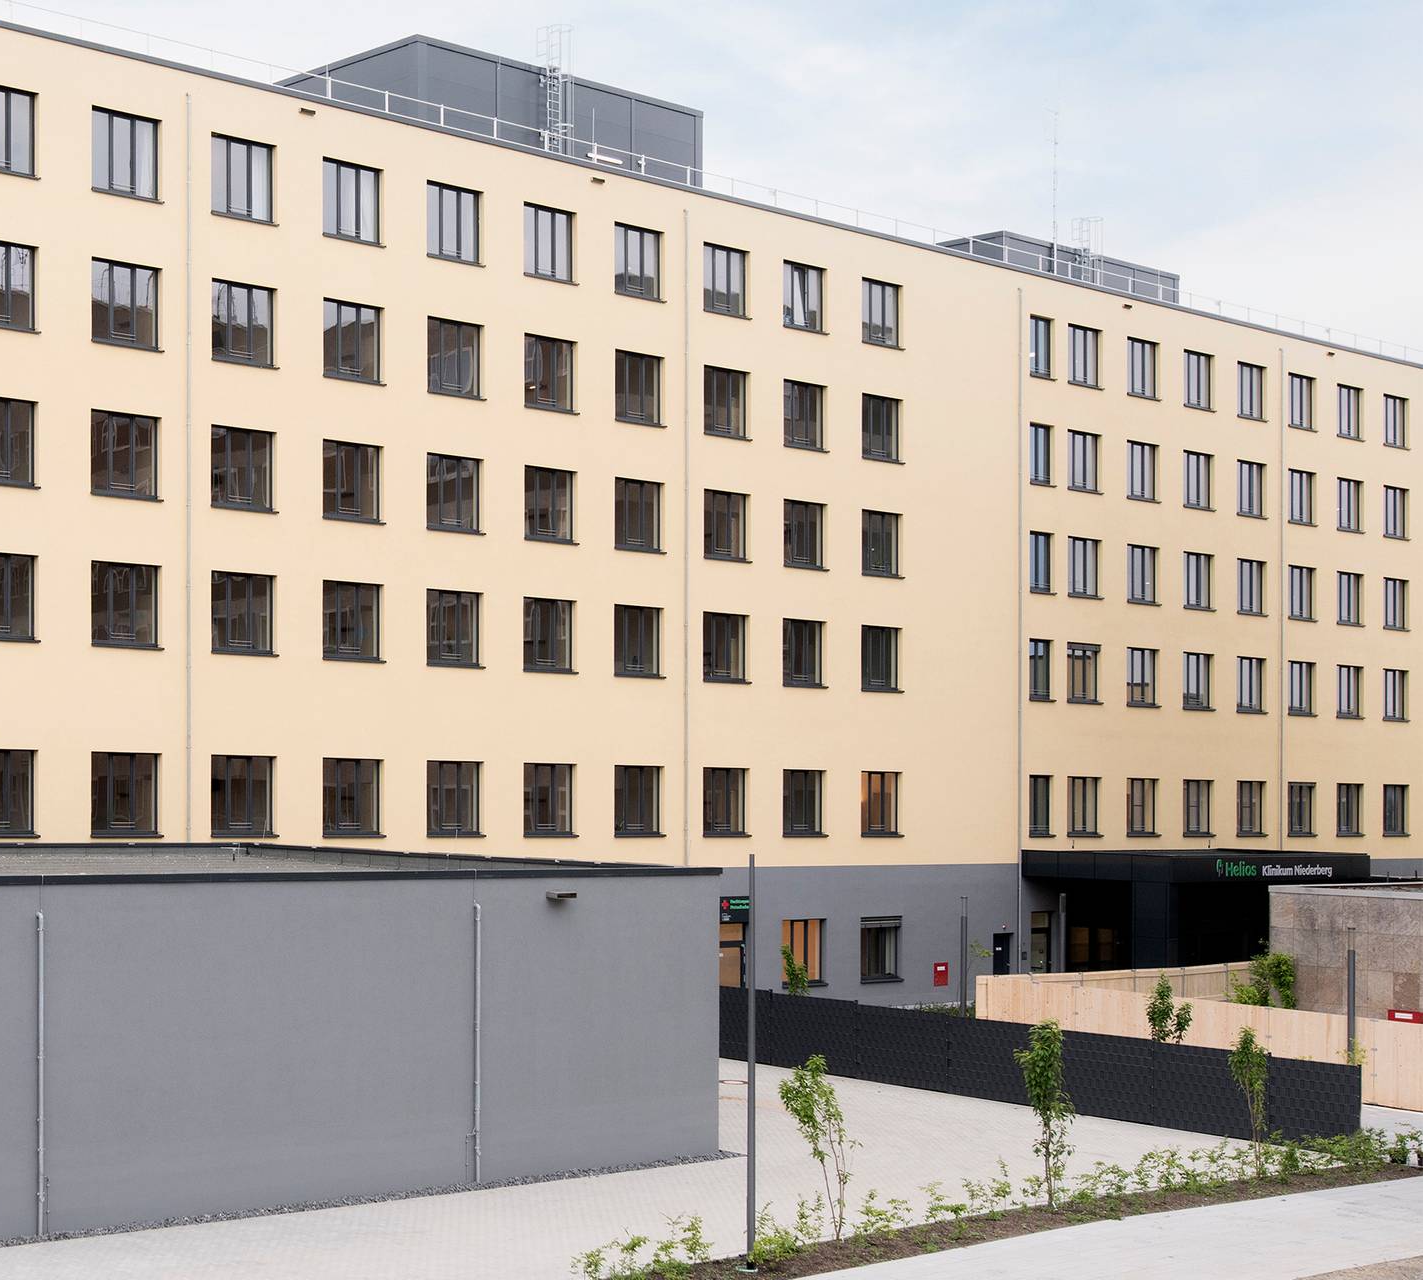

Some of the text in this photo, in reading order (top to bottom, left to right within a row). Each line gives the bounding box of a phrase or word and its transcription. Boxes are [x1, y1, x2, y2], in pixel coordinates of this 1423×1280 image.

[1225, 861, 1333, 878] Helios Klinikum Niederberg
